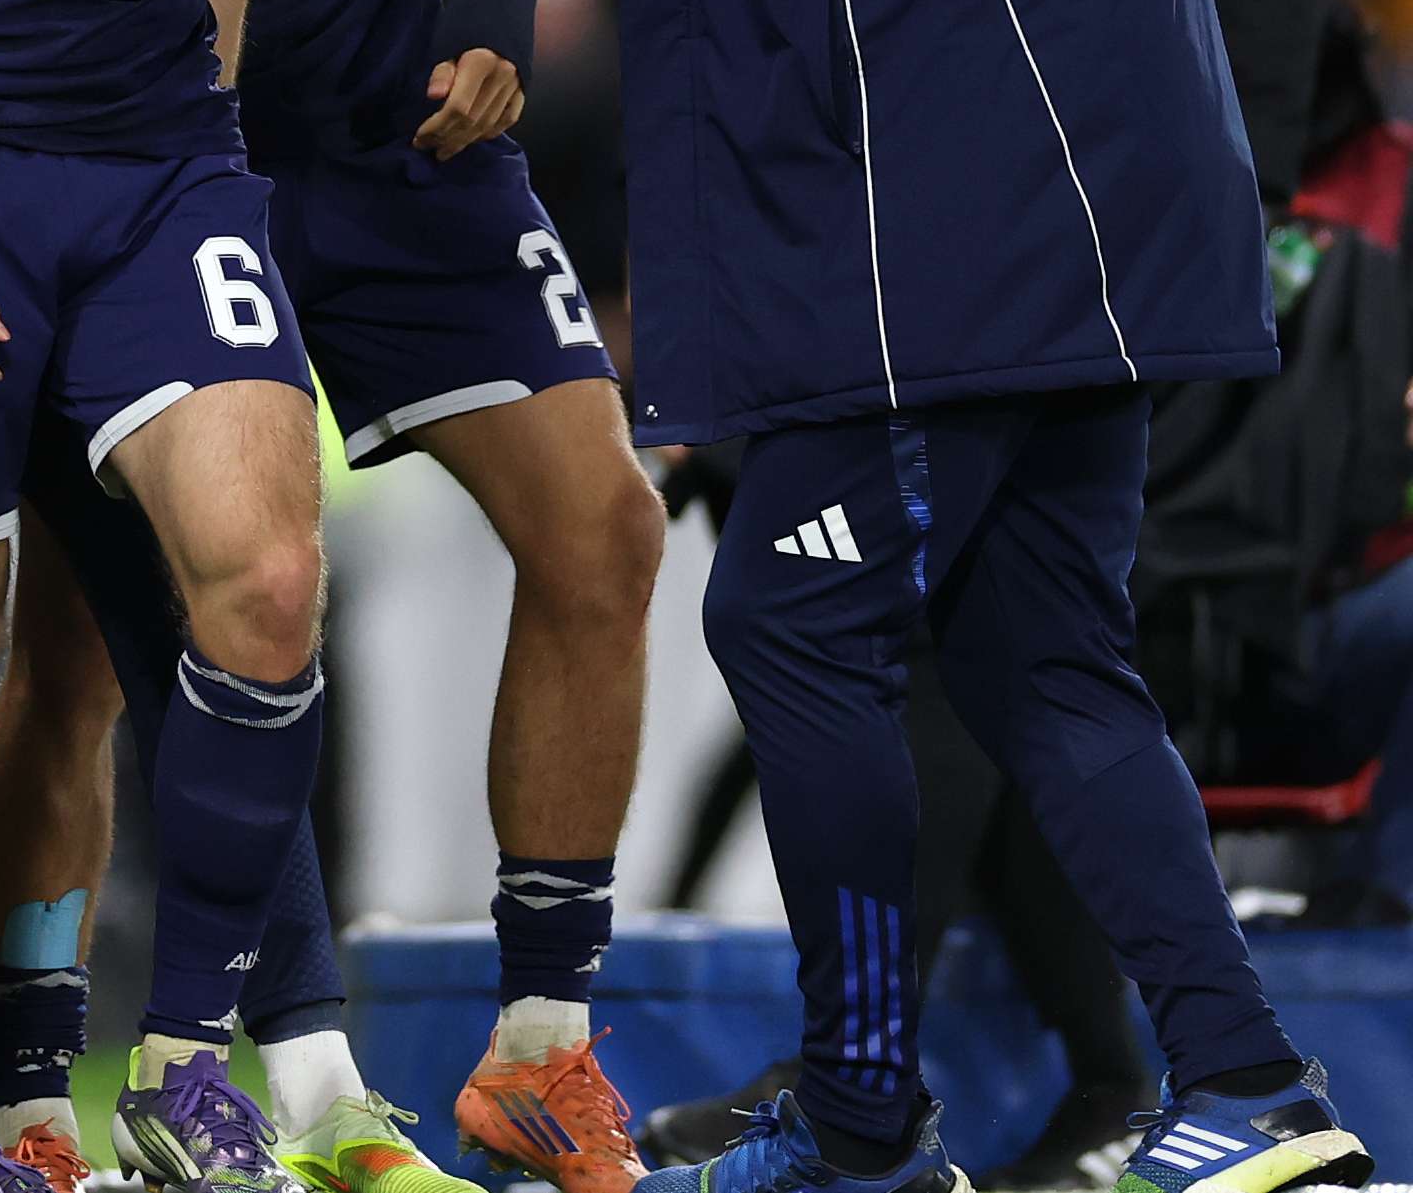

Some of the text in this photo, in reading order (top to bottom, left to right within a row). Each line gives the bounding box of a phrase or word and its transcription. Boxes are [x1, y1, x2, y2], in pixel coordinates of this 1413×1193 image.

[192, 235, 280, 349] 6
[517, 228, 603, 349] 2
[224, 946, 261, 971] AL
